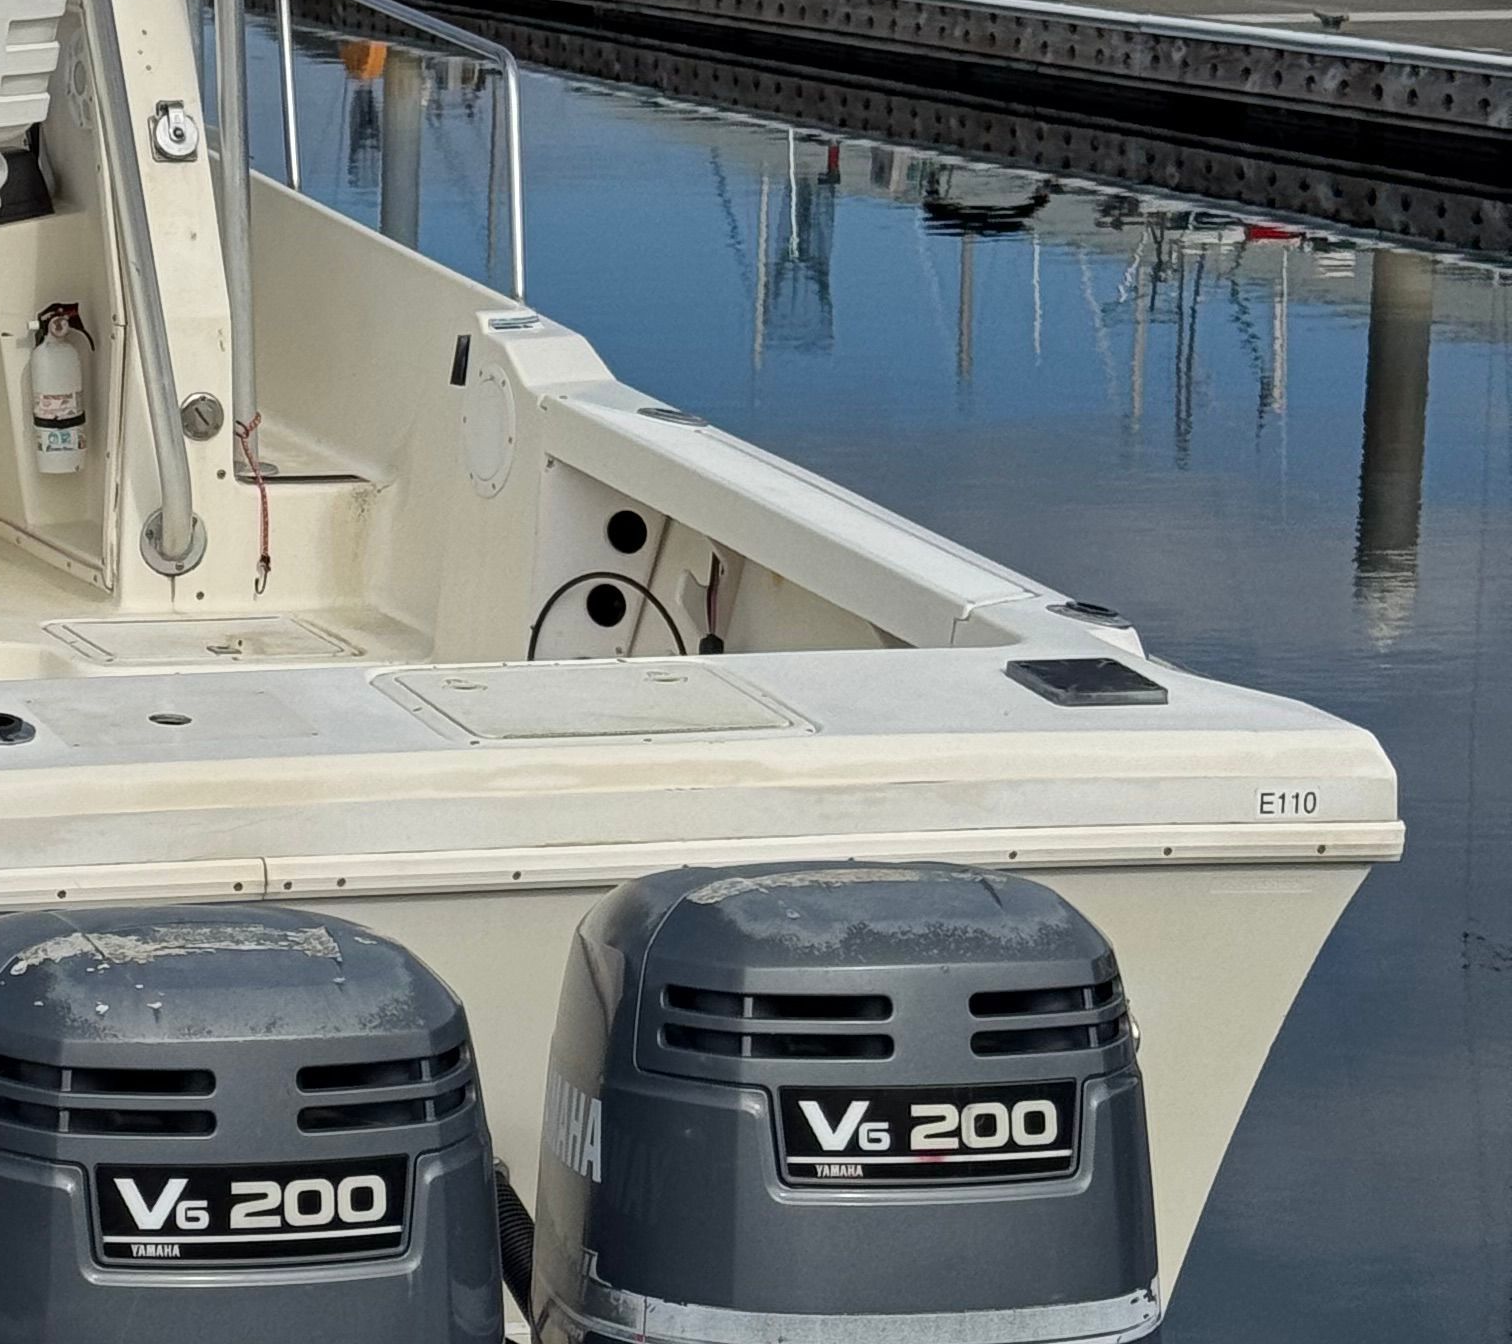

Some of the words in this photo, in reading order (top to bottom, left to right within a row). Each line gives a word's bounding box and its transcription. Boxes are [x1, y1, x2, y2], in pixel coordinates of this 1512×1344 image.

[1259, 791, 1317, 815] E110
[797, 1100, 891, 1151] V6
[909, 1099, 1058, 1151] 200
[815, 1164, 864, 1178] YAMAHA
[113, 1177, 210, 1230] V6
[229, 1174, 387, 1230] 200
[130, 1243, 181, 1258] YAMAHA
